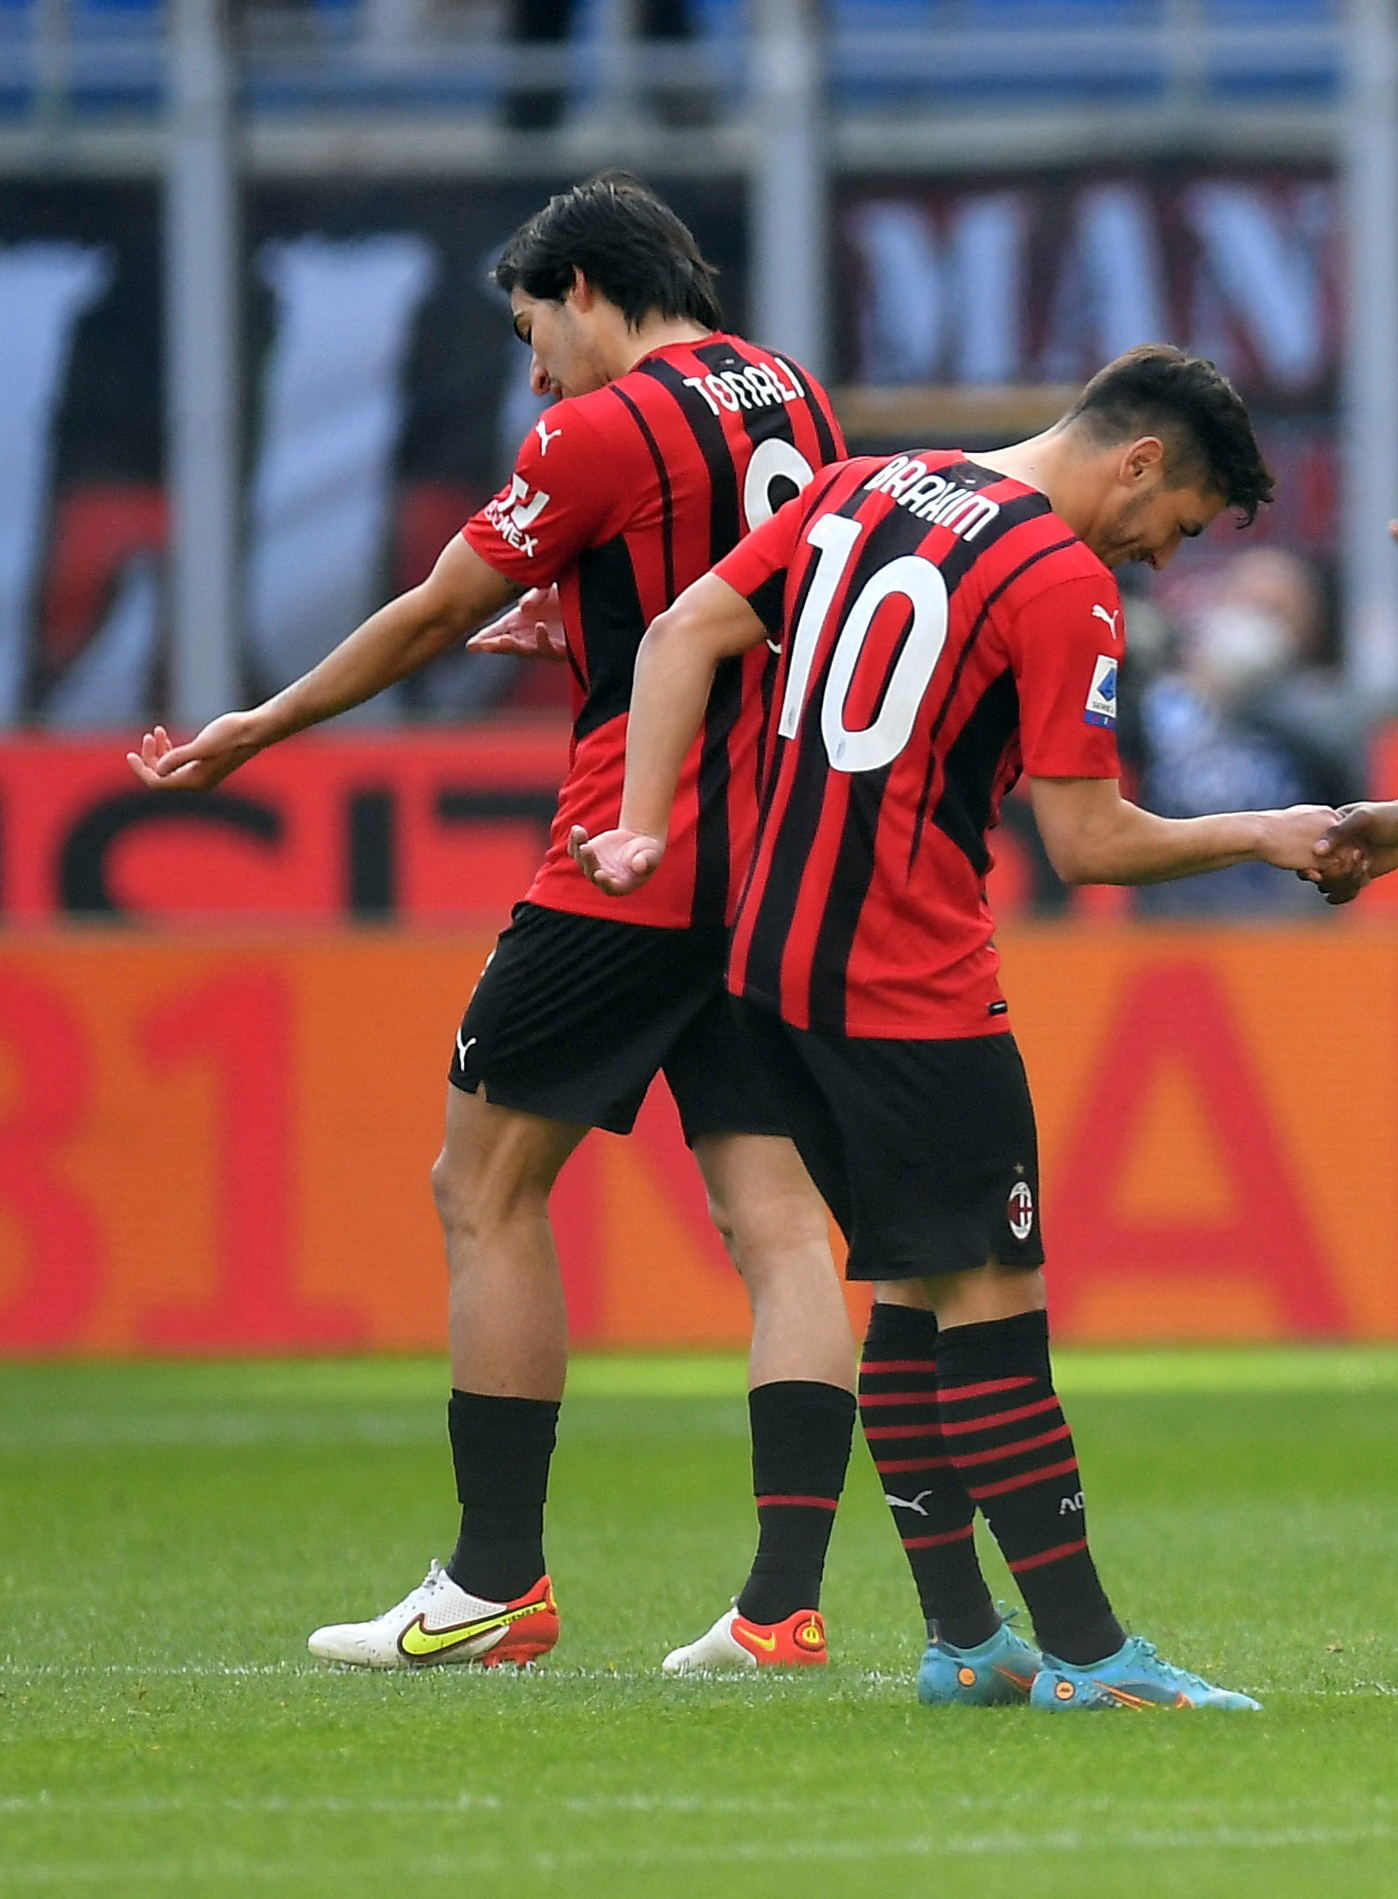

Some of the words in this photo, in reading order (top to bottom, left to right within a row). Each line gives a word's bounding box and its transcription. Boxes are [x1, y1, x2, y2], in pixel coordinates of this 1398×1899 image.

[682, 356, 805, 416] TONALI
[862, 455, 1000, 542] BRAHIM
[778, 512, 949, 773] 10
